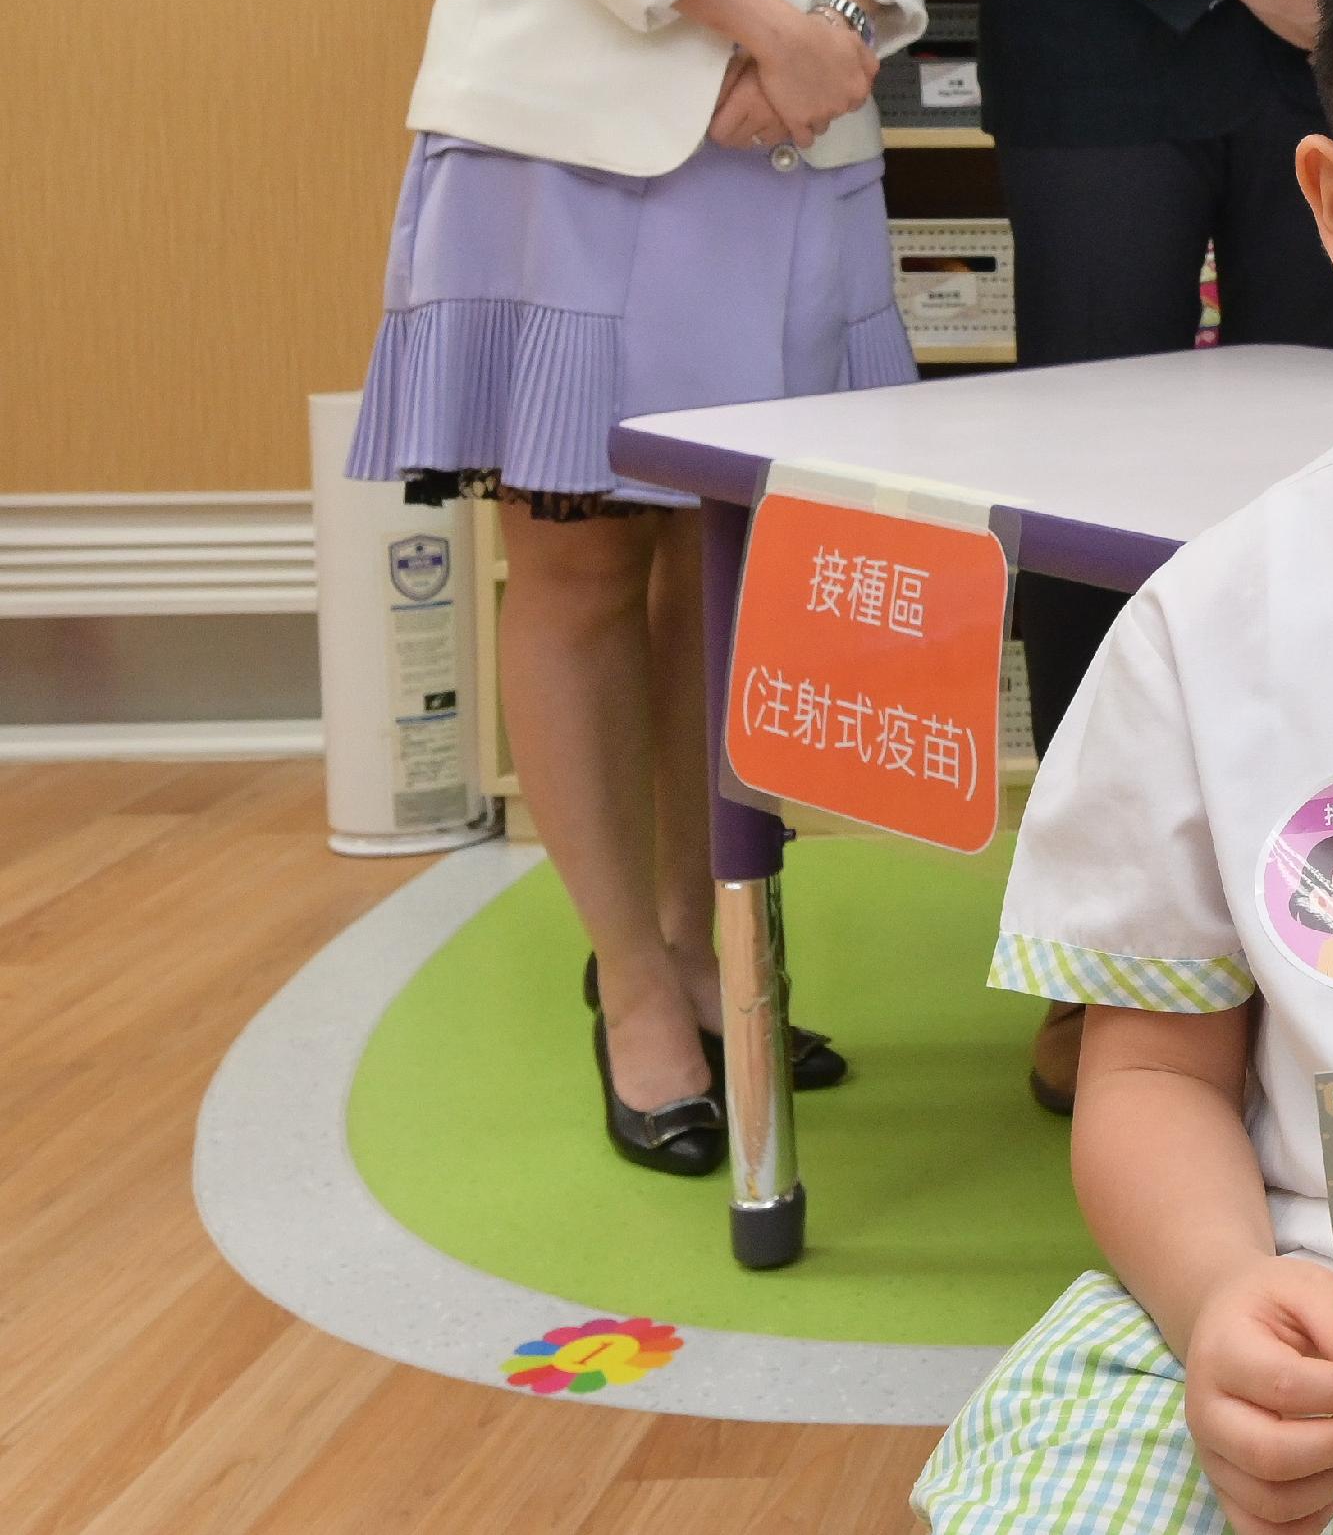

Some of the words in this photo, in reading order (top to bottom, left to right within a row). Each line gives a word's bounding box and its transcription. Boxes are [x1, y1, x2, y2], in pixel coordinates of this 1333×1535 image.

[805, 545, 931, 639] 接種區
[742, 664, 978, 802] (注射式疫苗)
